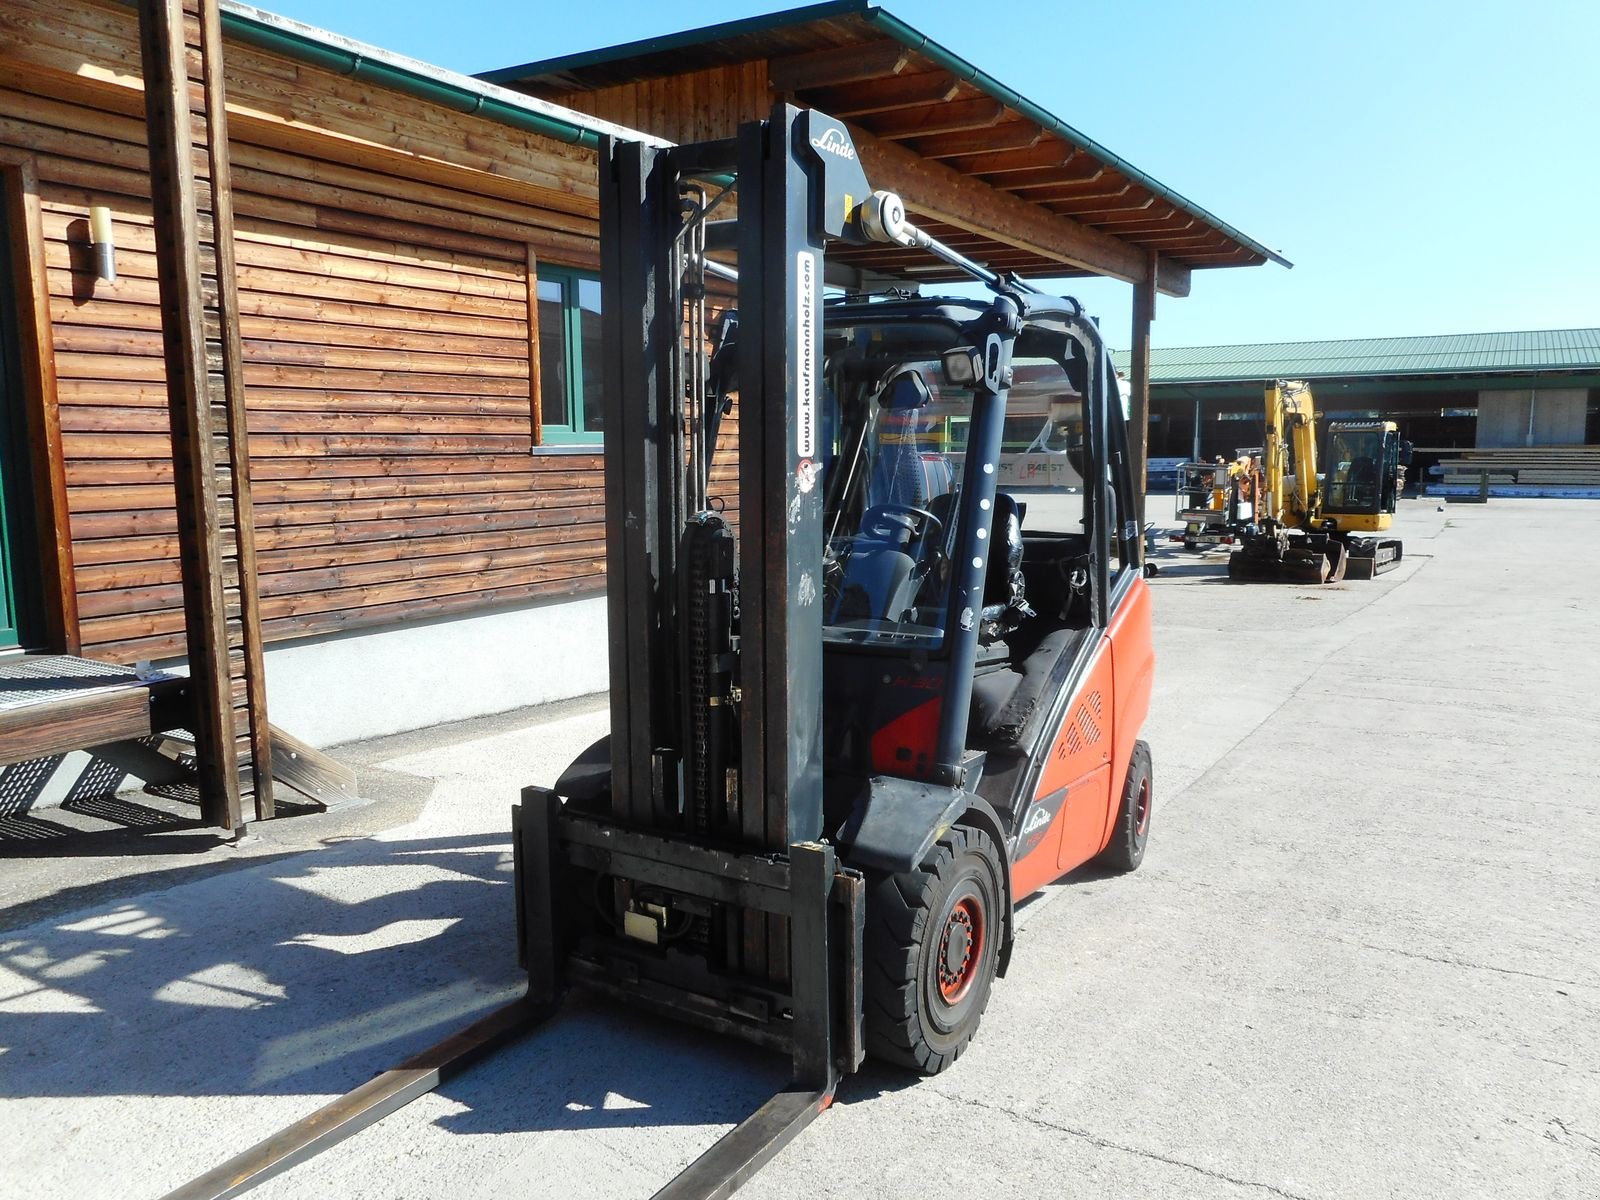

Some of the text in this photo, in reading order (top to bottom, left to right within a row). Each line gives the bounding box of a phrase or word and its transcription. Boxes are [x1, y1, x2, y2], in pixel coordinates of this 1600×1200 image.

[811, 128, 855, 160] Linde
[802, 259, 811, 452] www.kaufmannholz.com
[1024, 807, 1051, 834] Linde
